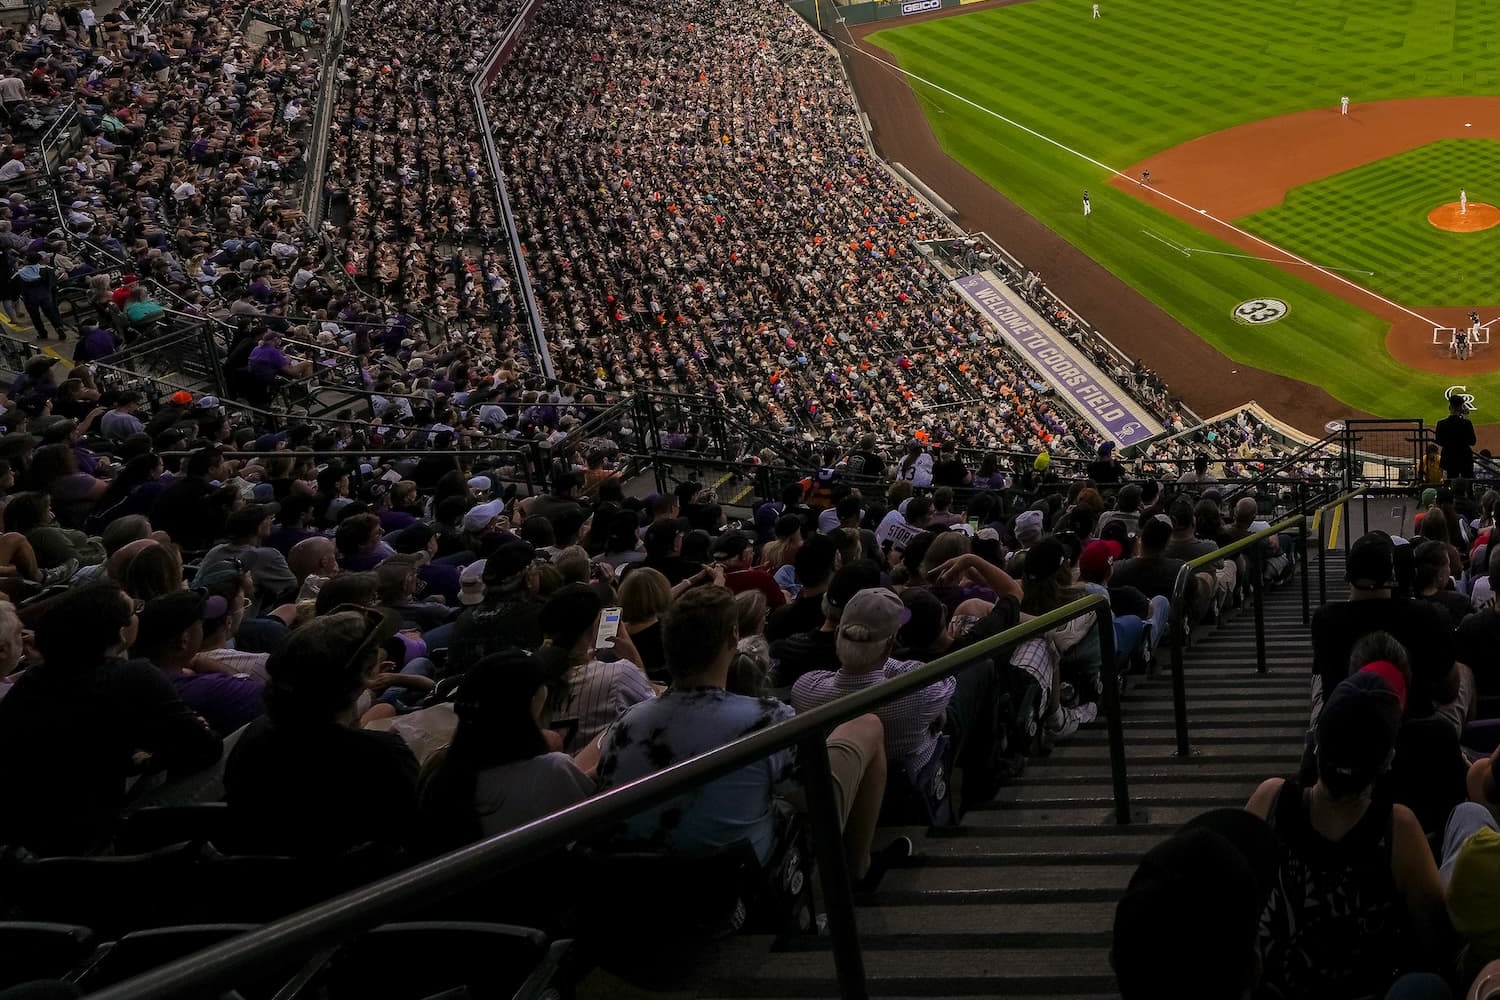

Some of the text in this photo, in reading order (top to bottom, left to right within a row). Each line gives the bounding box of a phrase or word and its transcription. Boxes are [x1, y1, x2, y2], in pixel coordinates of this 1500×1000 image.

[903, 0, 940, 12] GEICO
[1239, 302, 1280, 321] 33
[974, 287, 1126, 423] WELCOME TO COORS FIELD
